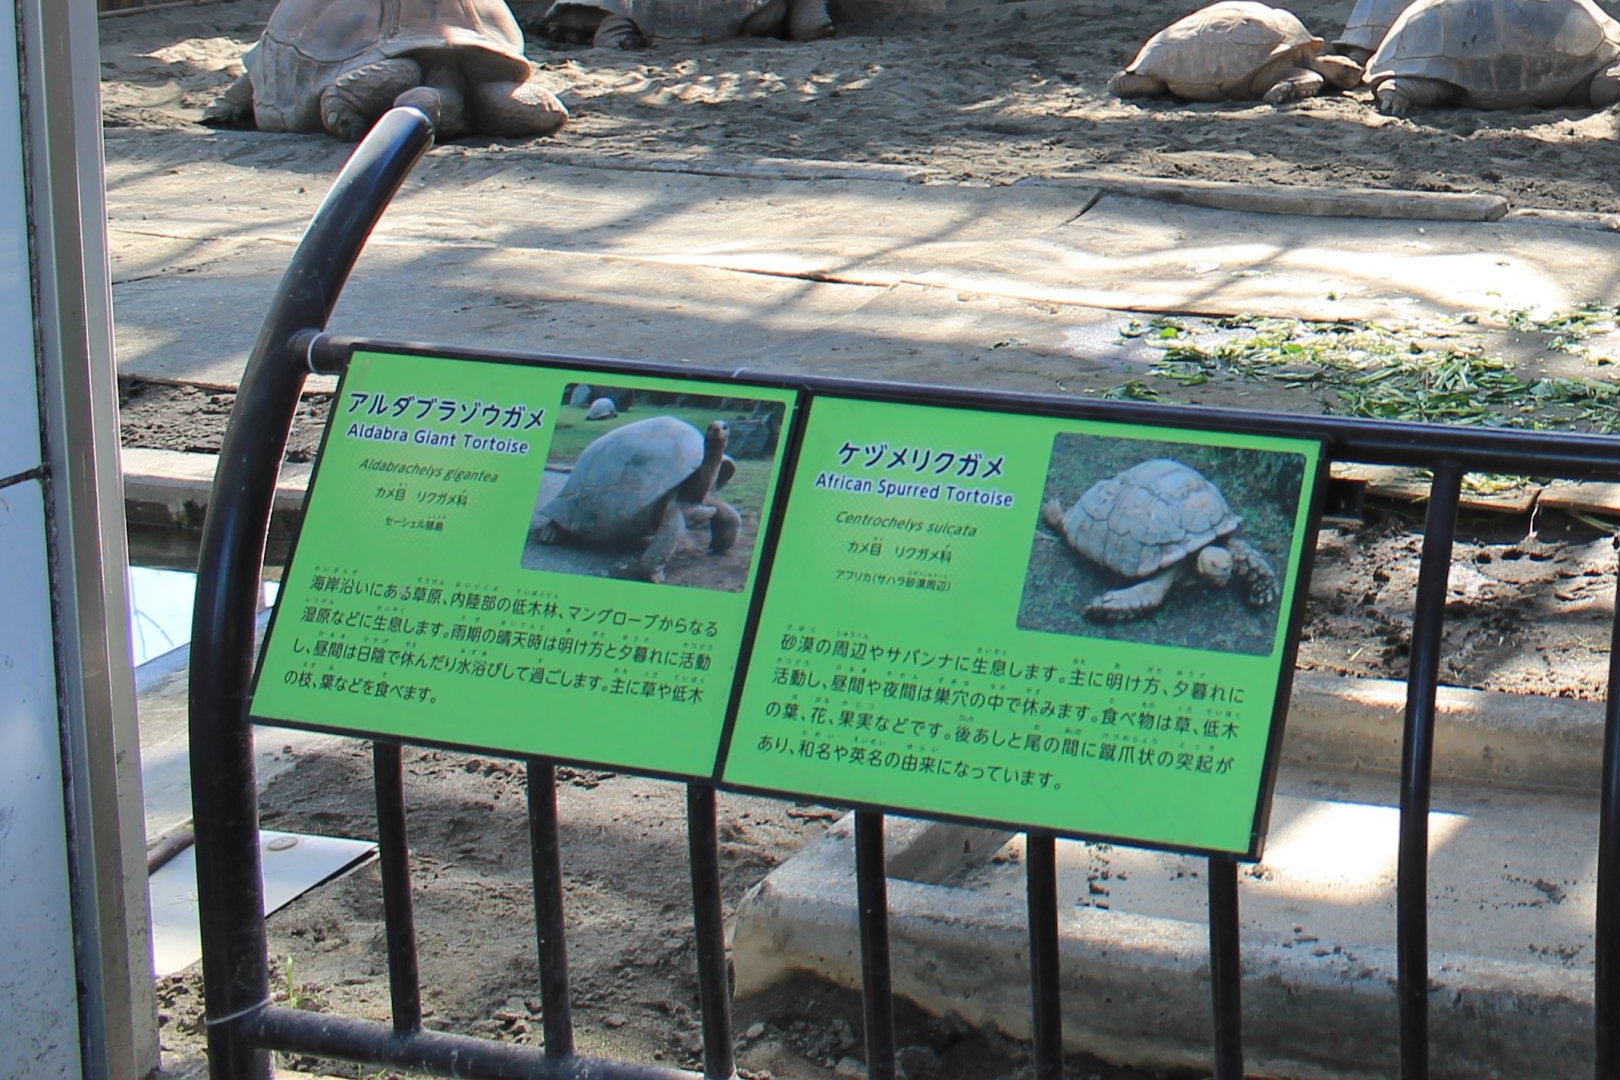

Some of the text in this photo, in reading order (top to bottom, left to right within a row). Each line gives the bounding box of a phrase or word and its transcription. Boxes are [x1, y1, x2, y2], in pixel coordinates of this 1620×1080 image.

[347, 392, 545, 430] アルダブラゾウガメ
[347, 423, 529, 454] Aldabra Giant Tortoise
[359, 458, 499, 484] Aldabrachelys gigantea
[838, 441, 1004, 478] ケヅメリクガメ
[375, 487, 468, 508] カメ目 リクガメ科
[815, 473, 1013, 507] African Spurred Tortoise
[836, 510, 977, 538] Centrochelys sulcata
[848, 540, 952, 564] カメ目 リクガメ科
[284, 669, 436, 704] の枝、葉などを食べます。
[757, 734, 1062, 791] あり、和名や英名の由来になっています。
